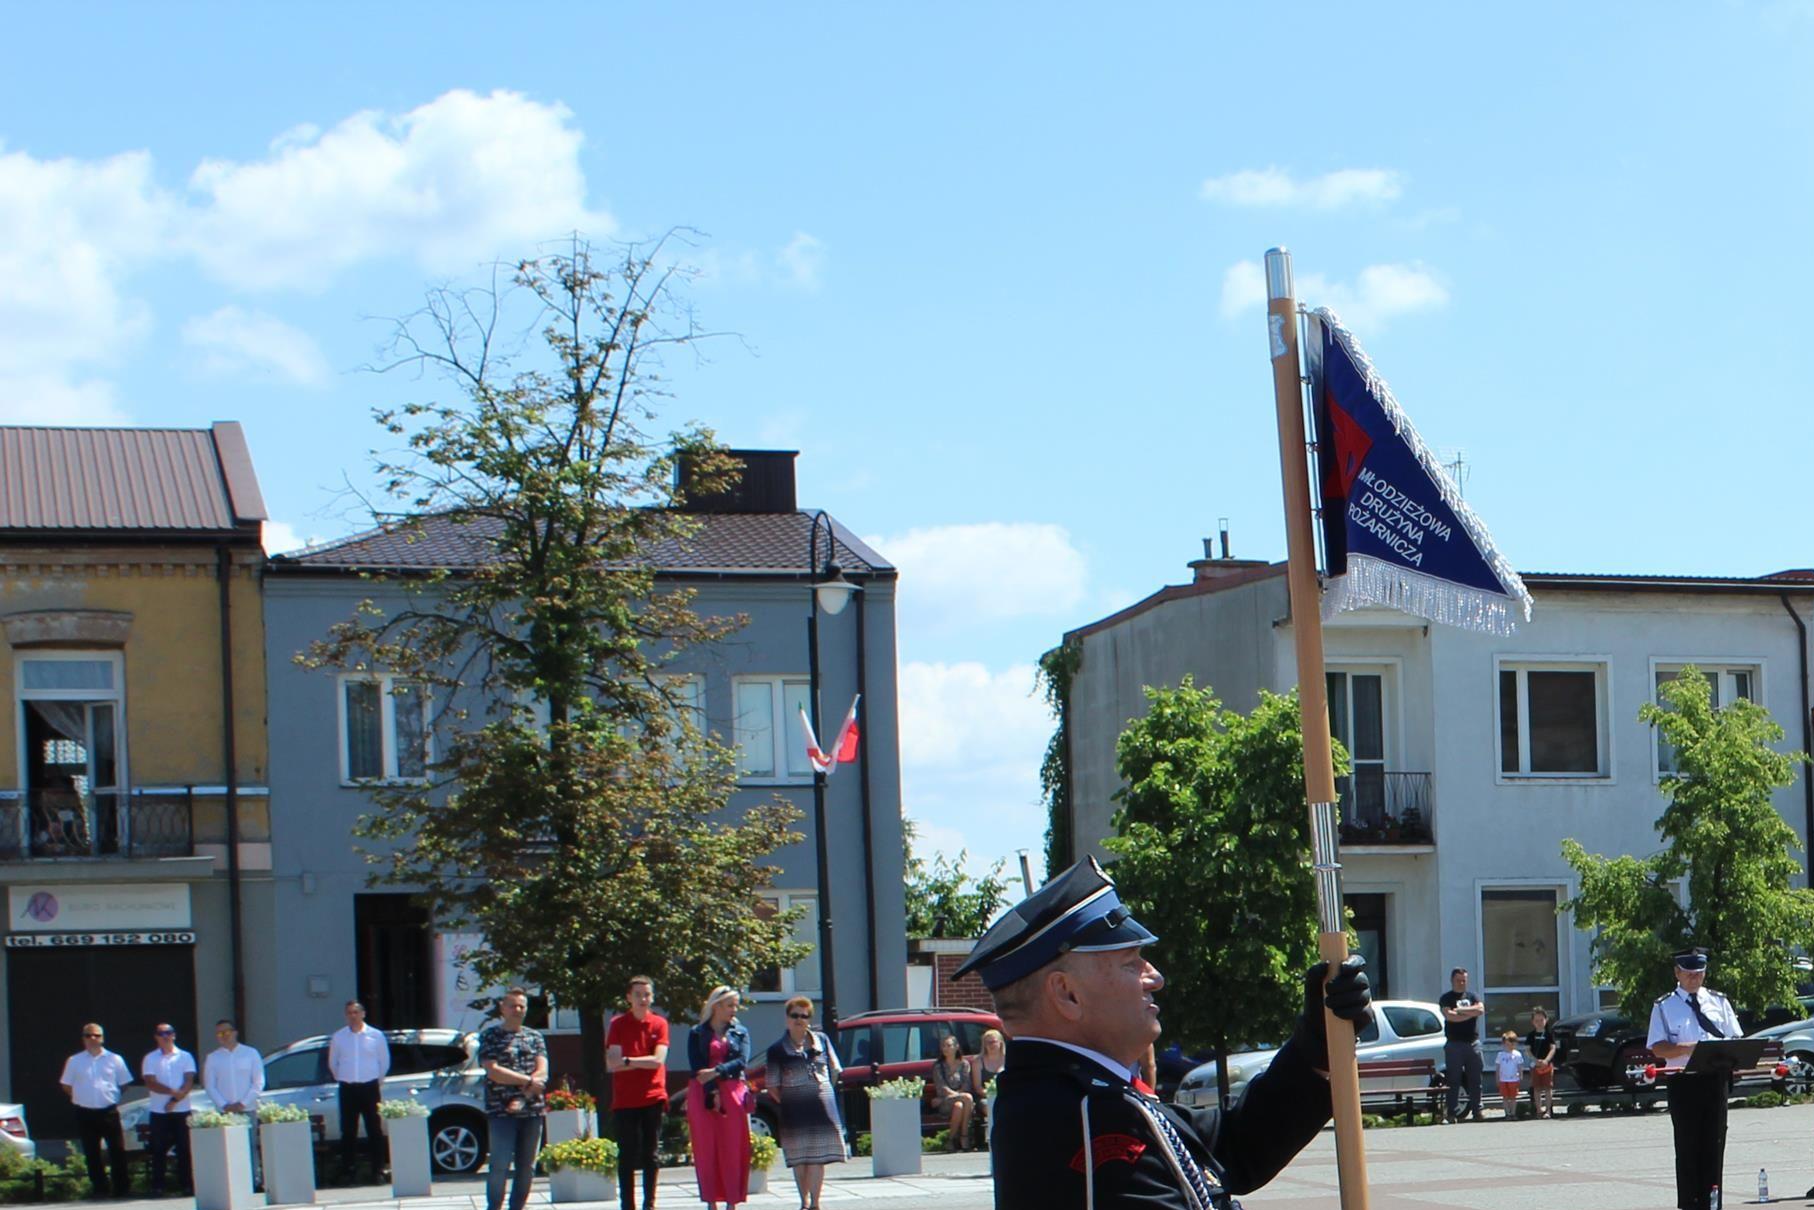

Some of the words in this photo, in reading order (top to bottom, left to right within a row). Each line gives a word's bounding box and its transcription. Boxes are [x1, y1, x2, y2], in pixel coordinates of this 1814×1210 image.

[1358, 467, 1451, 542] MŁODZIEŻOWA
[1360, 491, 1424, 545] DRUŻYNA
[1348, 502, 1423, 567] POŻARNICZA
[10, 936, 43, 946] tel.
[50, 935, 94, 945] 669
[102, 934, 141, 944] 152
[148, 932, 192, 944] 080
